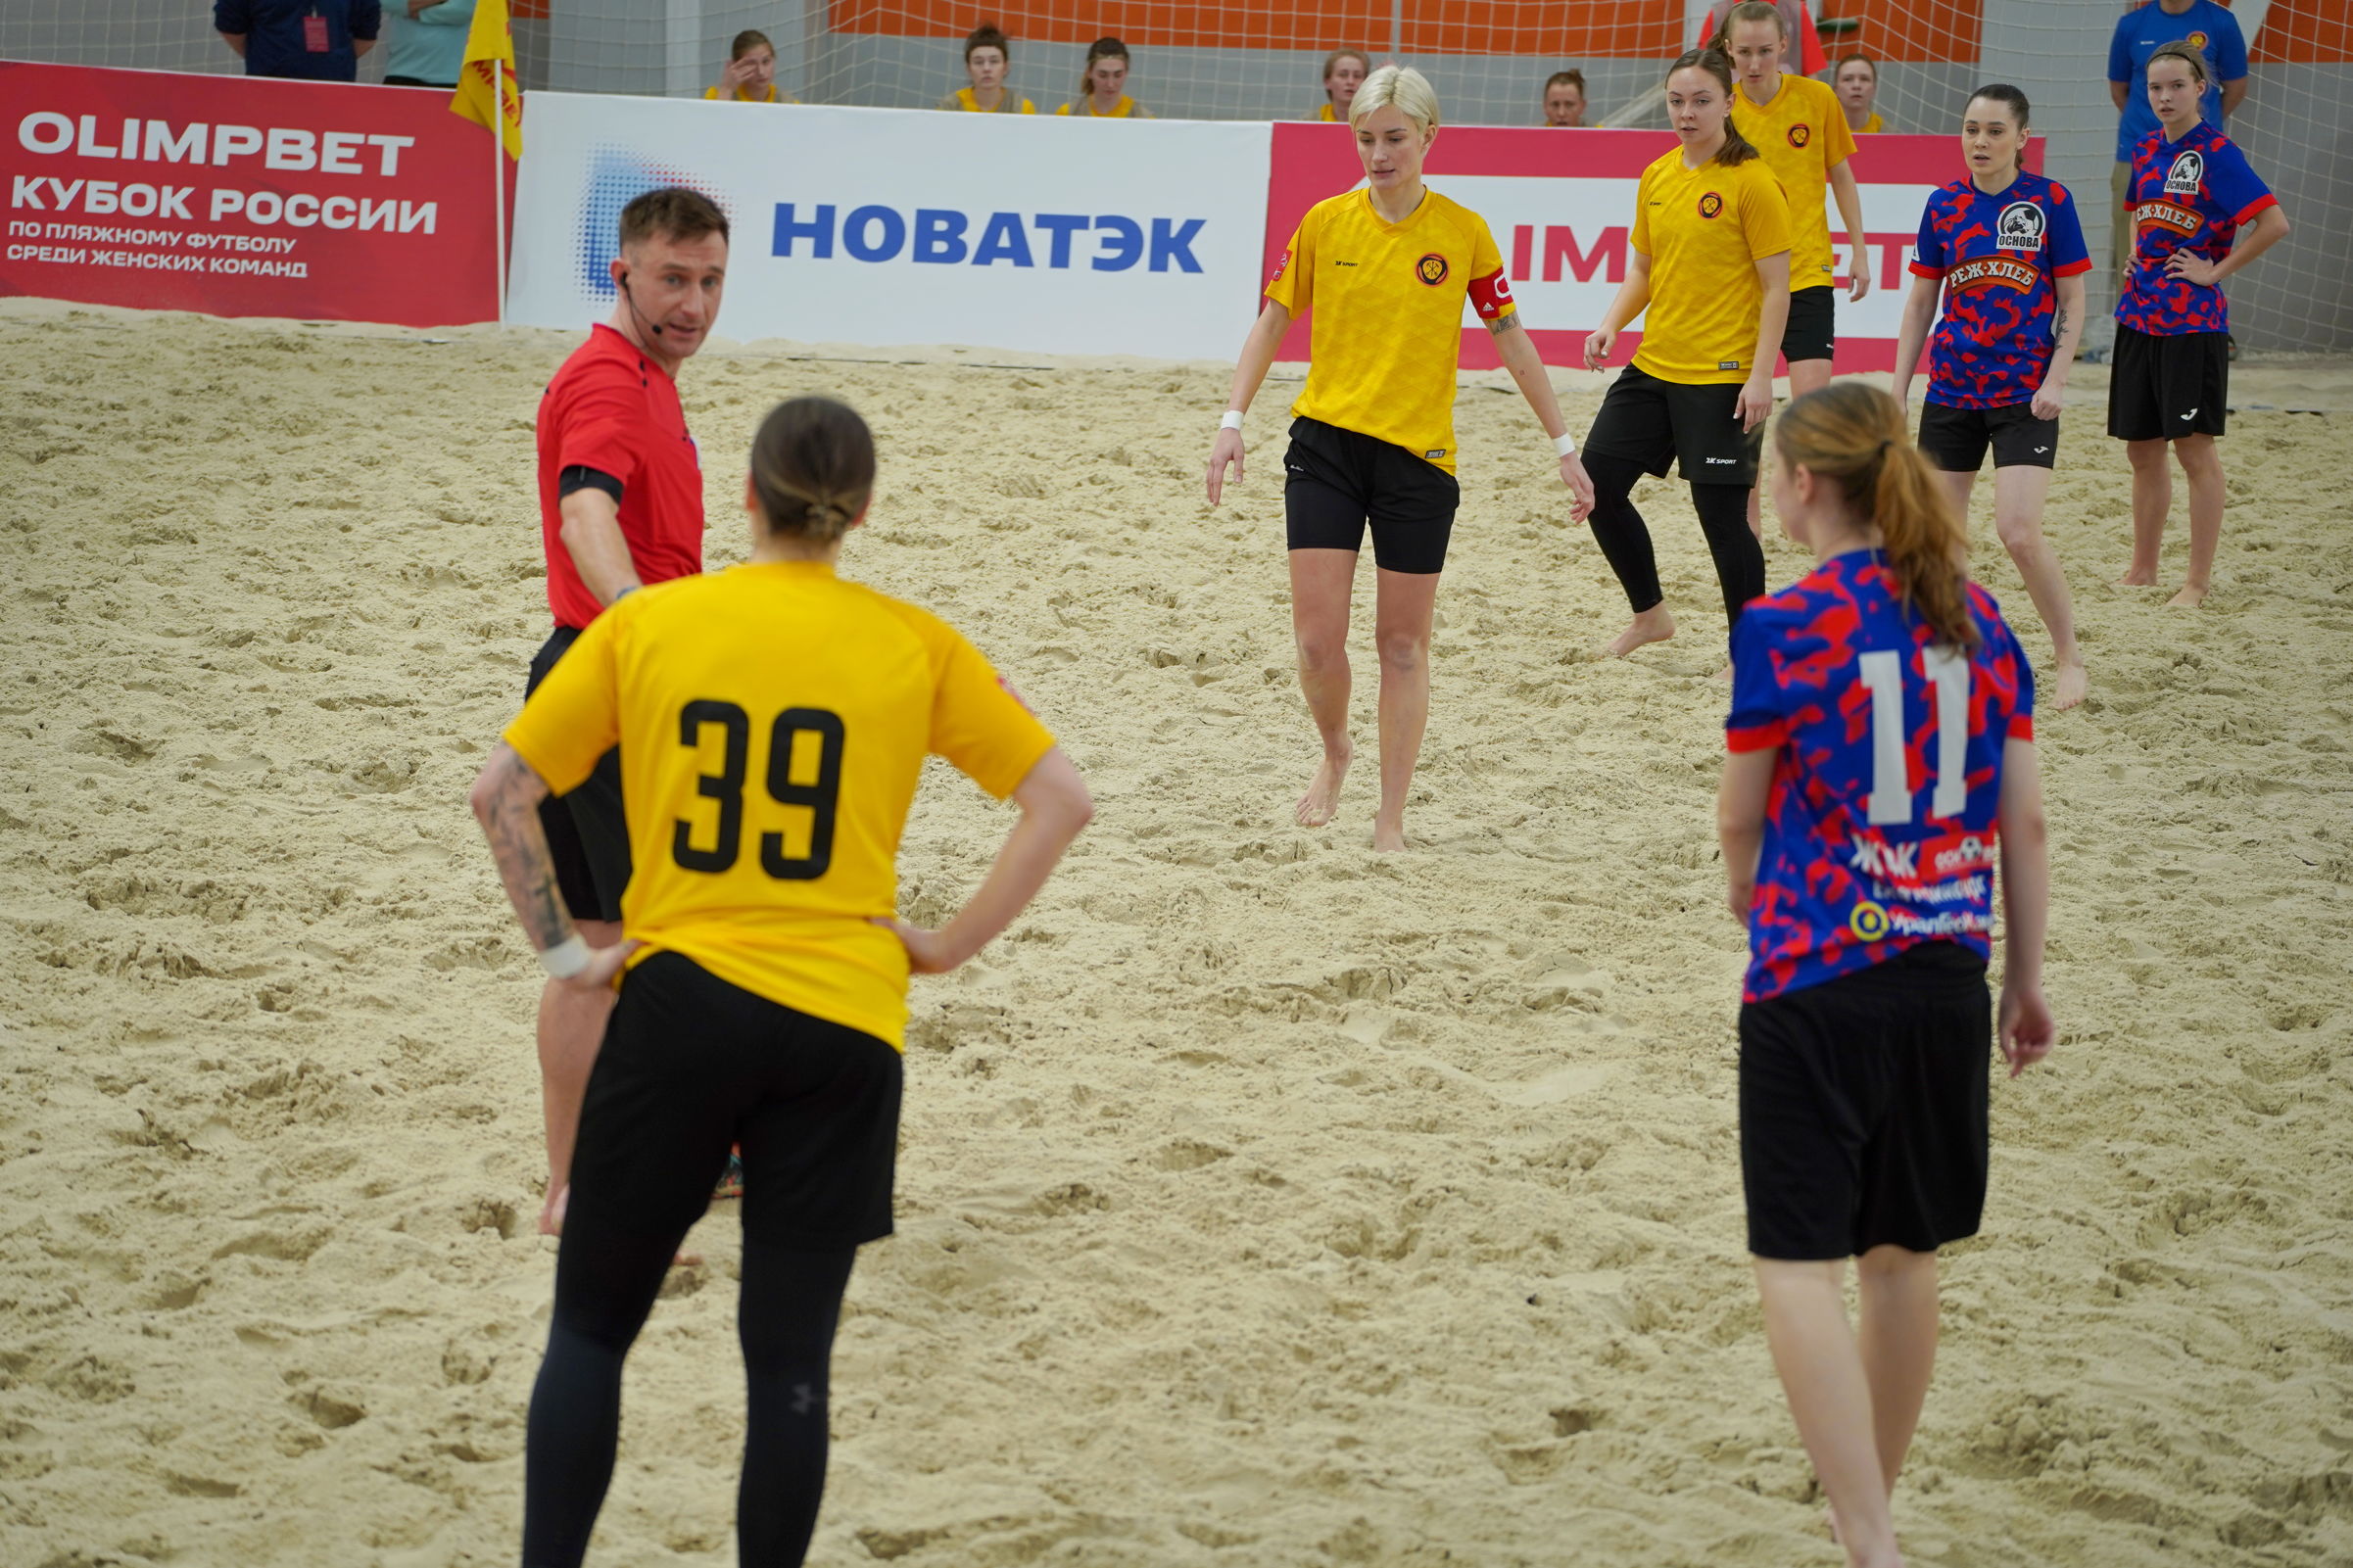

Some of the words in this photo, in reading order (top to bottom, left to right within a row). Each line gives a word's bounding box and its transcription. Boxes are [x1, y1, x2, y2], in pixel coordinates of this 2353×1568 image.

[18, 111, 415, 176] OLIMPBET
[11, 174, 196, 220] КУБОК
[209, 188, 438, 235] РОССИИ
[2166, 179, 2196, 192] ОСНОВА
[6, 244, 86, 265] СРЕДИ
[90, 249, 207, 272] ЖЕНСКИХ
[209, 257, 309, 278] КОМАНД
[8, 220, 41, 238] ПО
[45, 222, 182, 248] ПЛЯЖНОМУ
[186, 231, 297, 255] ФУТБОЛУ
[771, 202, 1207, 274] НОВАТЭК
[1998, 235, 2039, 249] ОСНОВА
[1859, 644, 1970, 825] 11
[673, 698, 844, 880] 39
